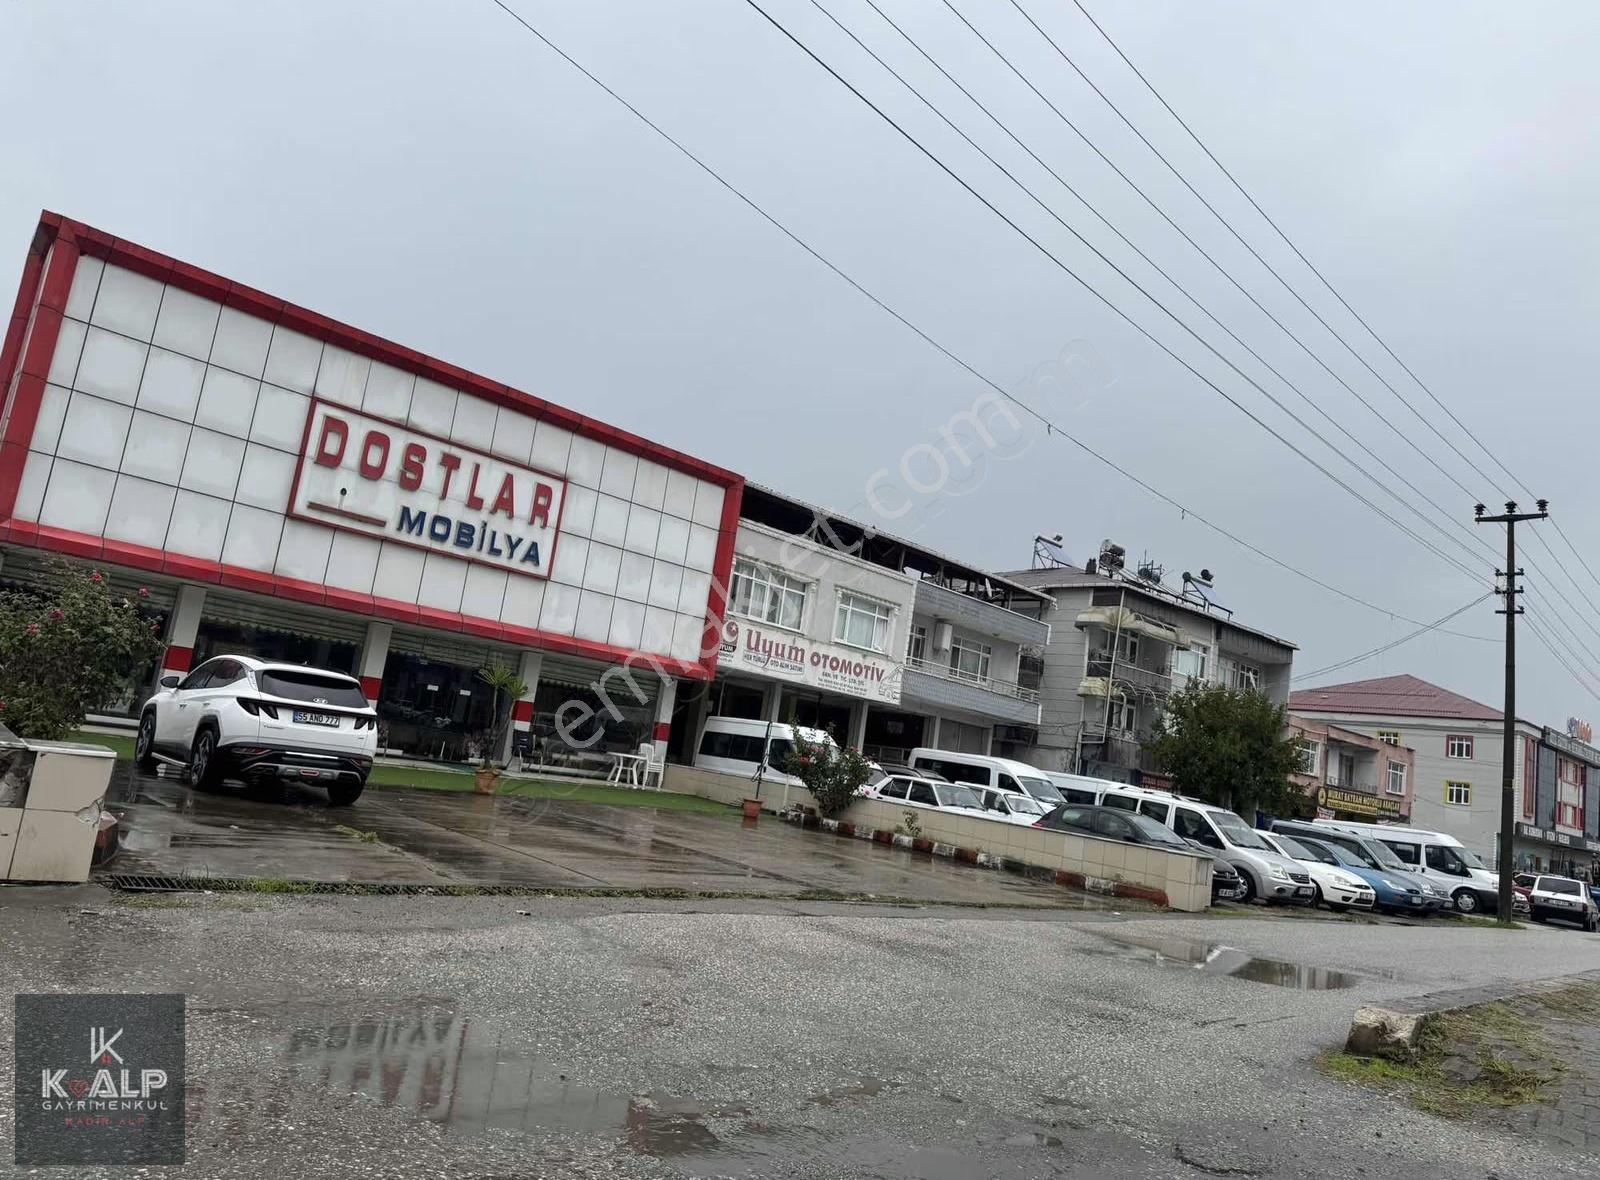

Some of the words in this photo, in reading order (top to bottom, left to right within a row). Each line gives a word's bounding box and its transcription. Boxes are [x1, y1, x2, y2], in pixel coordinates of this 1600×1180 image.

[314, 415, 553, 529] DOSTLAR
[396, 505, 541, 567] MOBİLYA
[746, 628, 806, 667] Uyum
[810, 651, 885, 682] OTOMOTİV
